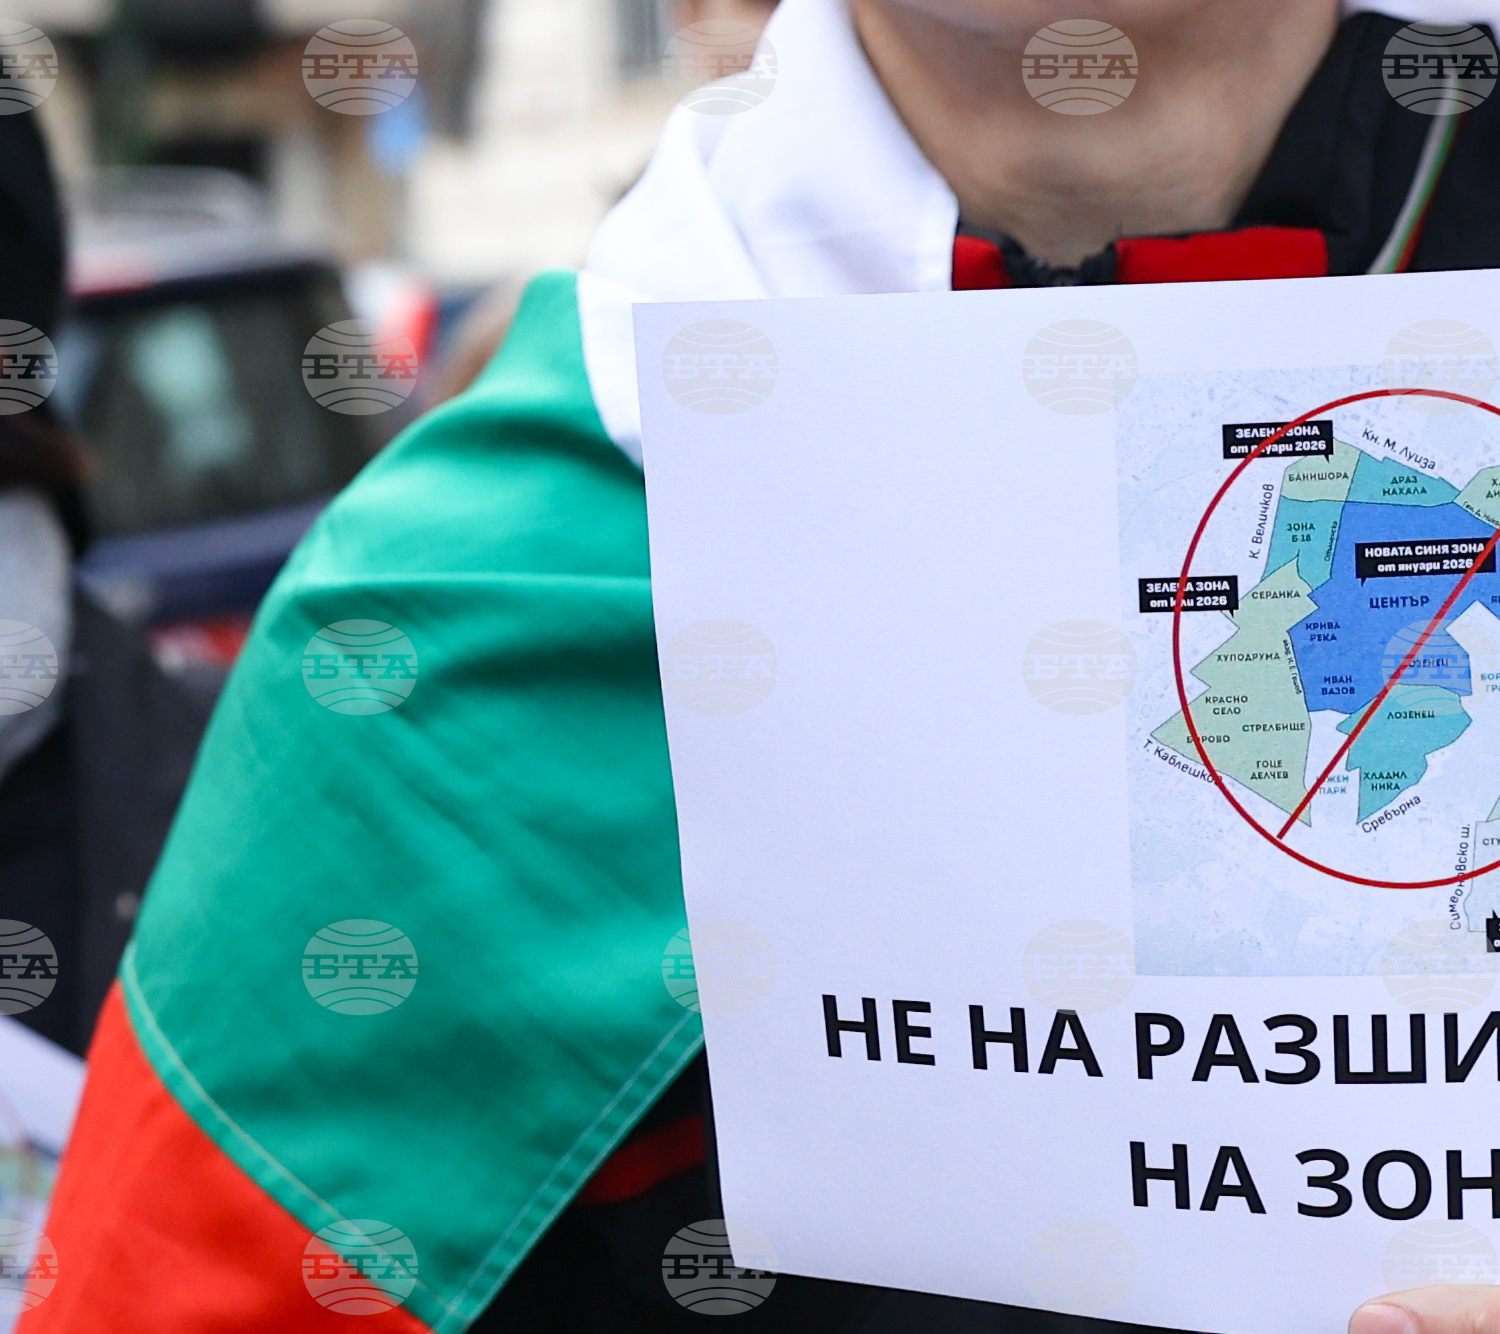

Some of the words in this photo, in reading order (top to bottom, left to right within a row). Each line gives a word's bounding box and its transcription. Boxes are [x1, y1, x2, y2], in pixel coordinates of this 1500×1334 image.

[1286, 425, 1320, 437] ЗОНА
[1230, 445, 1248, 454] от
[1250, 443, 1293, 455] яуари
[1295, 440, 1326, 451] 2026
[1362, 427, 1380, 445] Кн.
[1384, 437, 1396, 453] М.
[1398, 446, 1436, 470] Луиза
[1288, 471, 1349, 482] БАНИШОРА
[1391, 475, 1418, 485] ДРАЗ
[1252, 483, 1274, 545] Величков
[1286, 522, 1316, 531] ЗОНА
[1364, 546, 1413, 557] НОВАТА
[1414, 545, 1449, 555] СИНЯ
[1452, 543, 1484, 553] ЗОНА
[1377, 563, 1396, 572] от
[1398, 561, 1441, 573] януари
[1442, 559, 1474, 569] 2026
[1146, 581, 1194, 593] ЗЕЛЕА
[1196, 580, 1230, 591] ЗОНА
[1251, 590, 1300, 599] СЕРДИКА
[1150, 597, 1168, 608] от
[1196, 595, 1228, 607] 2026
[1370, 595, 1430, 609] ЦЕНТЪР
[1306, 622, 1341, 631] КРИВА
[1310, 633, 1338, 642] РЕКА
[1401, 659, 1449, 667] ОЗЕНЕЦ
[1324, 675, 1352, 684] ИВАН
[1321, 686, 1356, 695] ВАЗОВ
[1205, 695, 1248, 705] КРАСНО
[1212, 706, 1241, 715] СЕЛО
[1387, 711, 1436, 719] ЛОЗЕНЕЦ
[1242, 723, 1306, 733] СТРЕЛБИЩЕ
[1186, 735, 1230, 743] БРОВО
[1256, 760, 1282, 769] ГОЦЕ
[1250, 771, 1288, 780] ДЕЛЧЕВ
[1316, 775, 1349, 783] ЖЕН
[1363, 771, 1408, 780] ХЛАДИЛ
[1319, 787, 1347, 795] ПАРК
[1371, 783, 1400, 791] НИКА
[1362, 795, 1421, 833] Сребърна
[821, 993, 936, 1067] НЕ
[968, 1004, 1104, 1078] НА
[1129, 1141, 1267, 1215] НА
